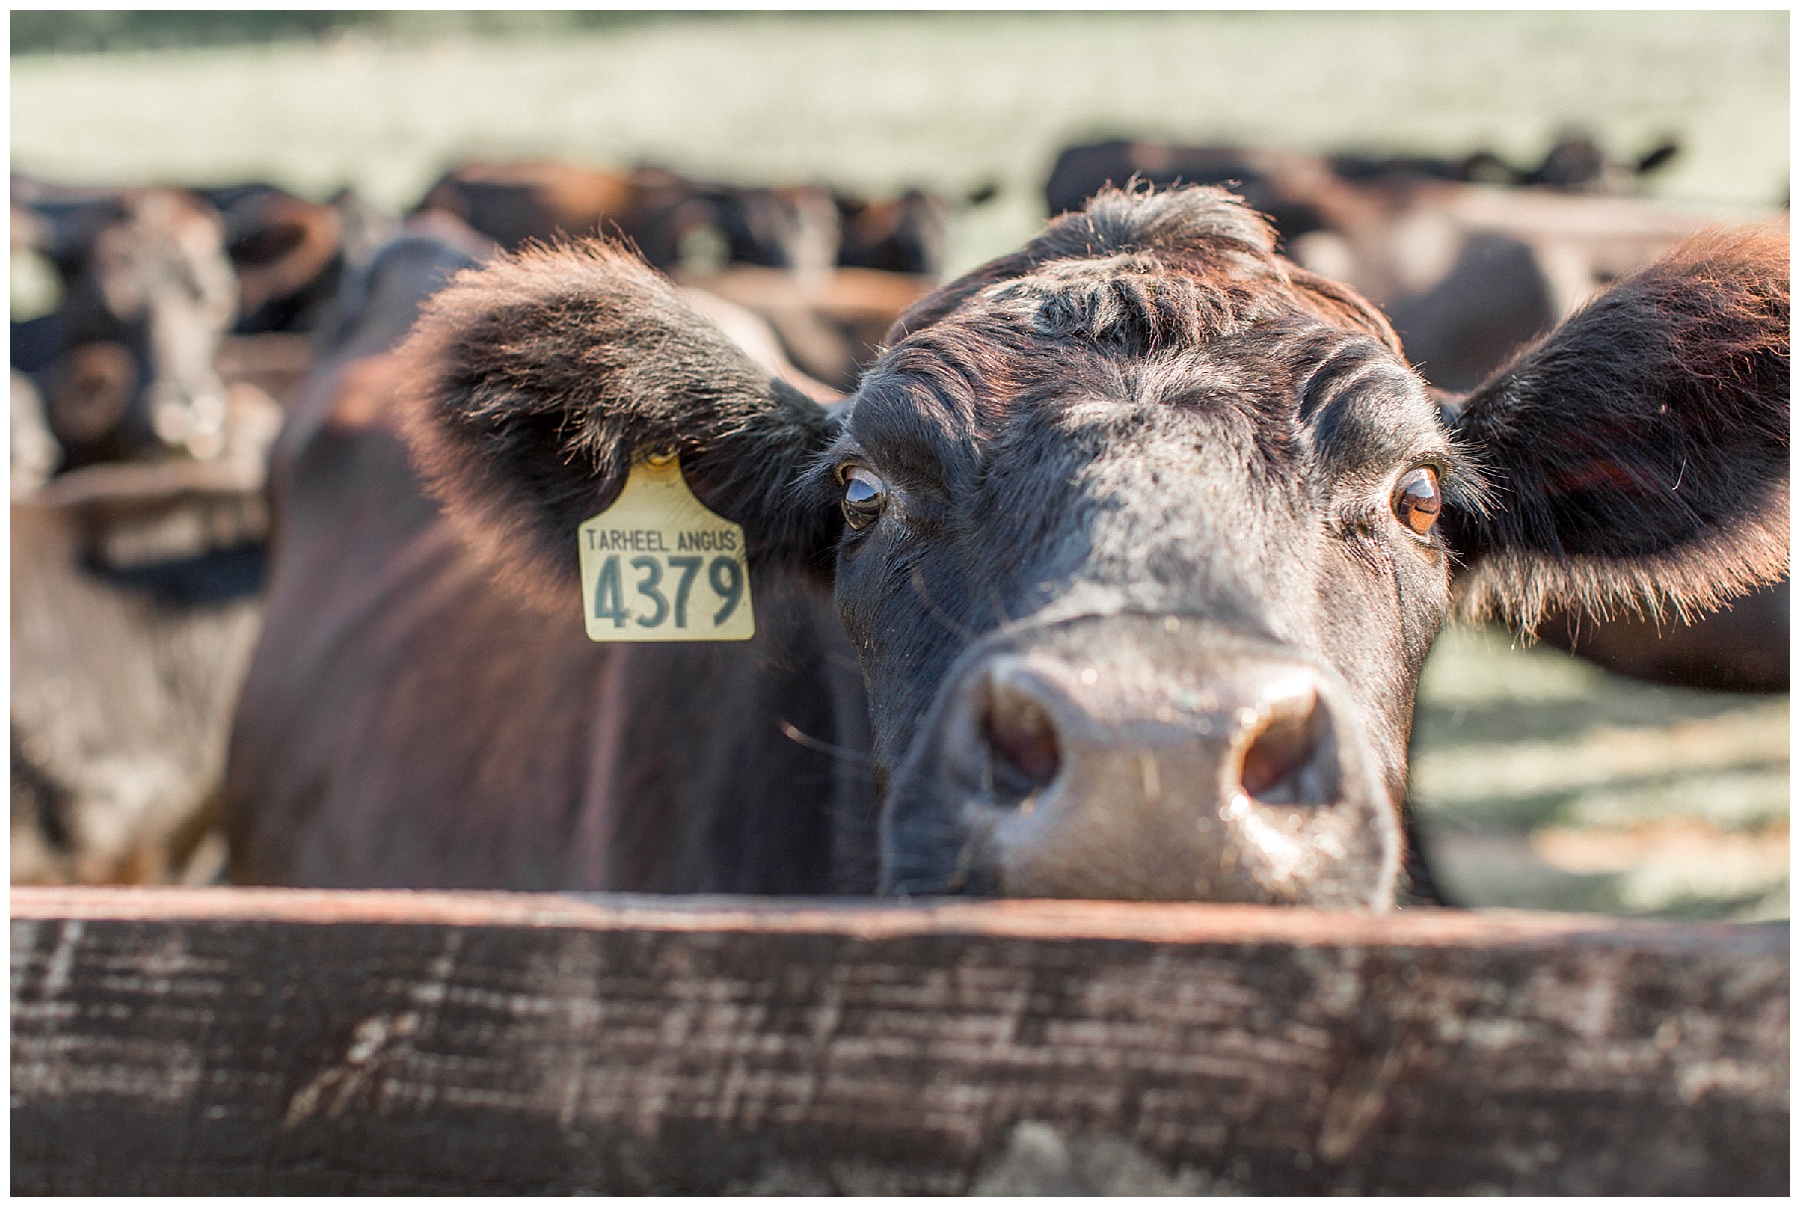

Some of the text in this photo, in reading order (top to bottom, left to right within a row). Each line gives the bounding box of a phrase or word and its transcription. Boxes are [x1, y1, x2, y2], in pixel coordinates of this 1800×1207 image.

[586, 529, 737, 551] TARHEEL ANGUS
[594, 555, 744, 629] 4379
